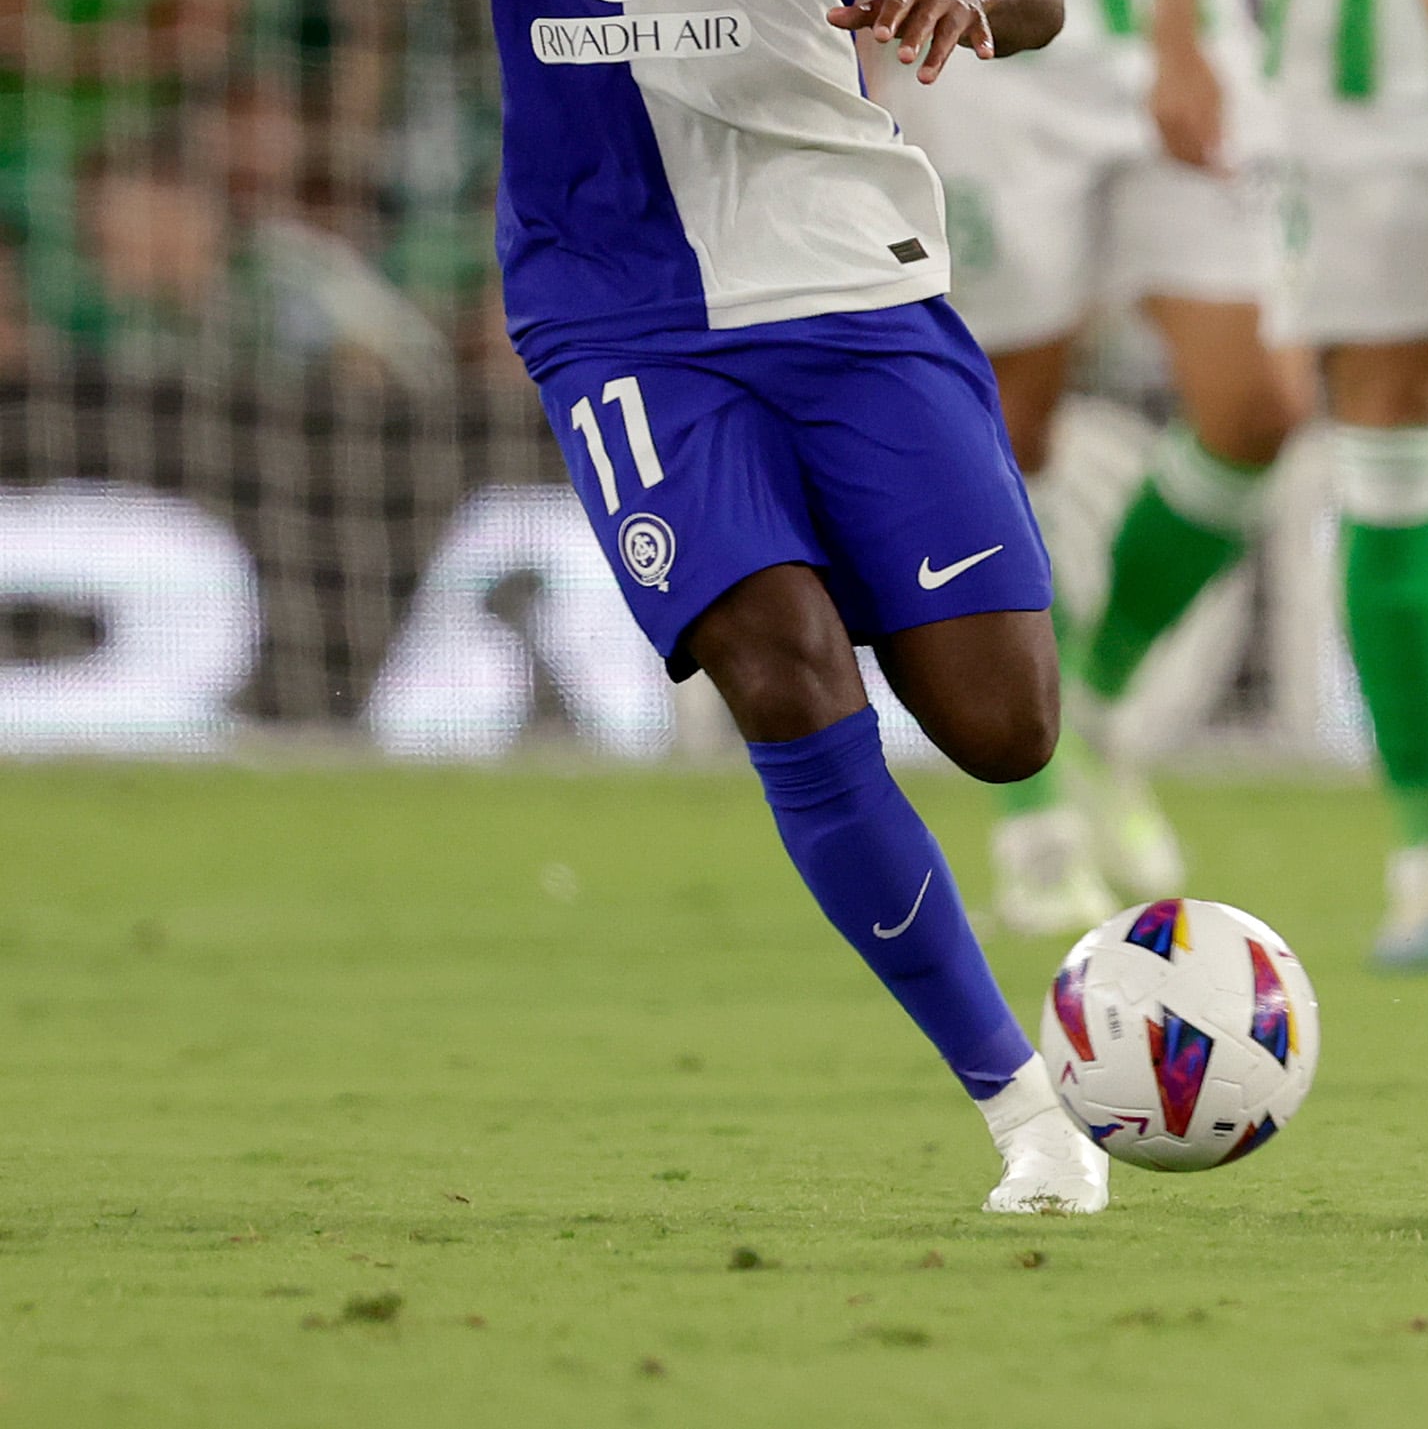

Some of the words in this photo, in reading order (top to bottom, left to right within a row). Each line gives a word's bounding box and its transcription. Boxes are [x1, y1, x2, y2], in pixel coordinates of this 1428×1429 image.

[538, 23, 661, 57] RIYADH
[674, 15, 741, 52] AIR
[568, 375, 665, 516] 11
